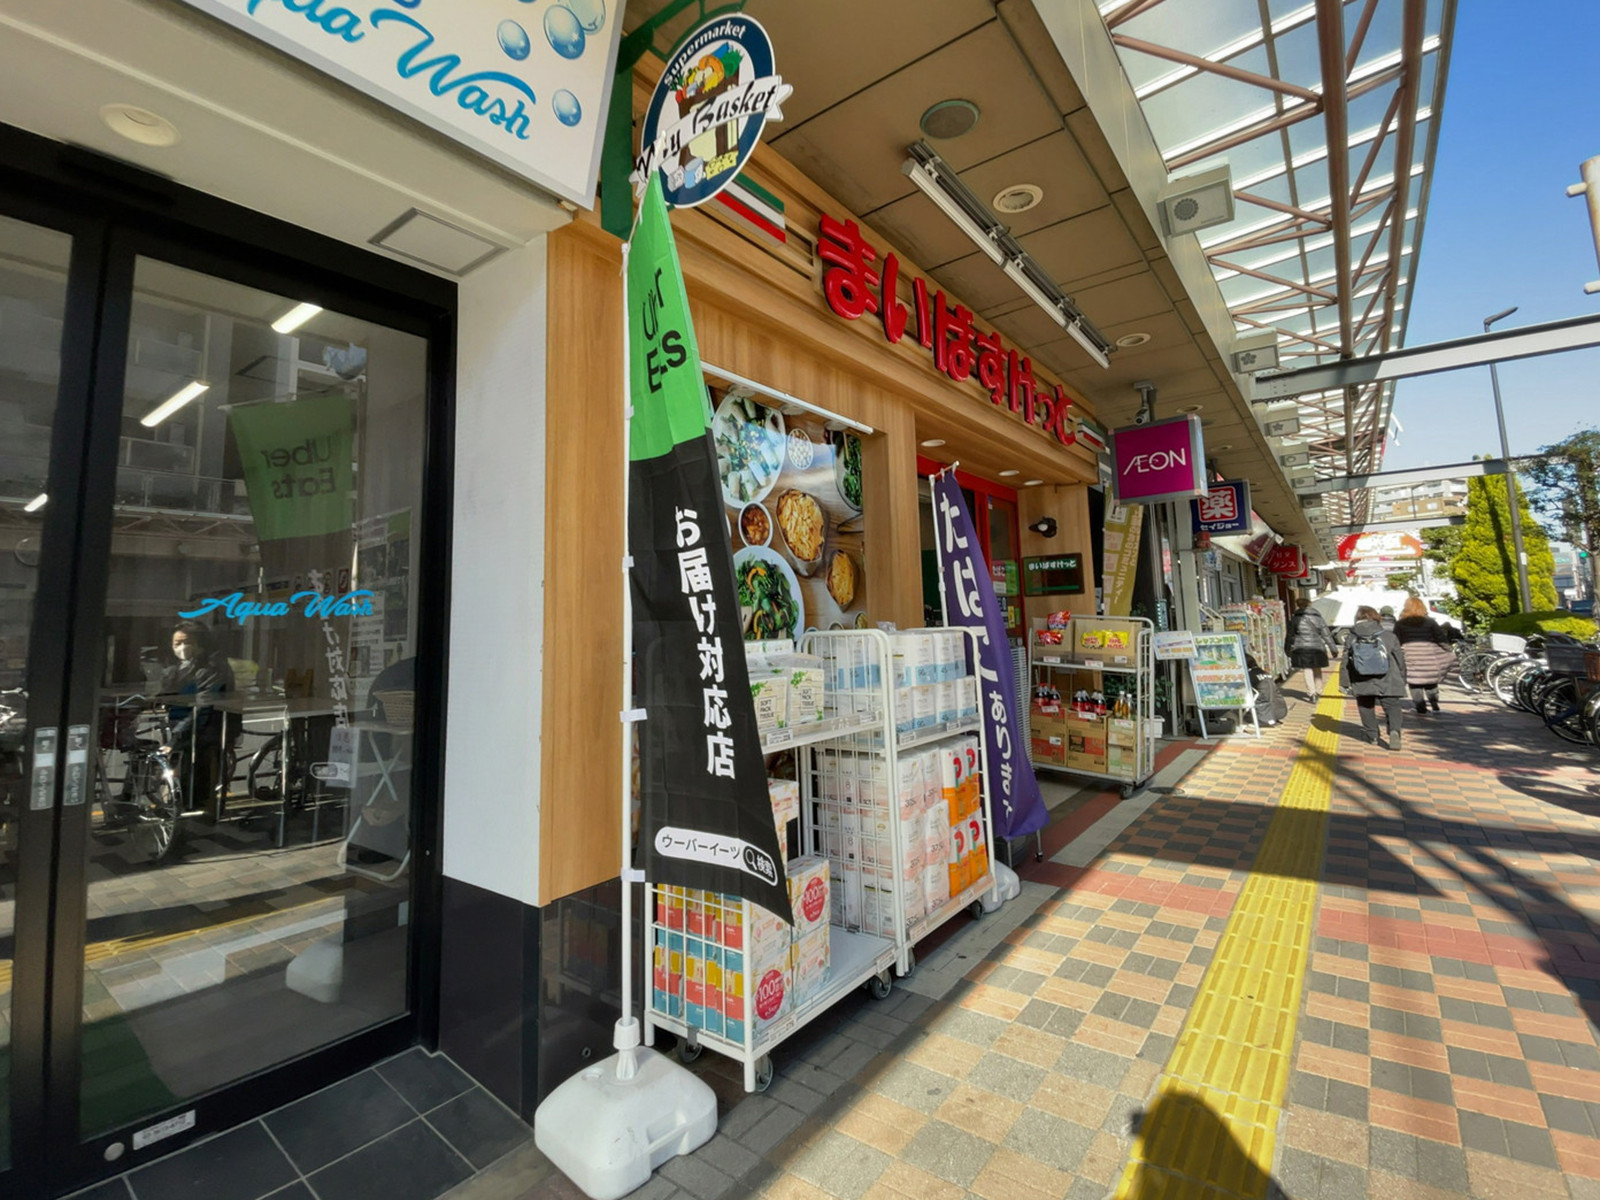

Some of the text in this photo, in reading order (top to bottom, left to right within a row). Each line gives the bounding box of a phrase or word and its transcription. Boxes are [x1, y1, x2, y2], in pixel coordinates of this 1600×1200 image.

[369, 8, 537, 140] Wash
[664, 20, 746, 86] Supermarket
[692, 80, 778, 135] Basket
[817, 213, 1076, 446] まいばすけっと
[1200, 522, 1240, 531] セイジョー
[1202, 490, 1234, 519] 薬
[178, 589, 375, 626] Aqua Wash
[675, 506, 736, 780] お届け対応店
[662, 834, 741, 860] ウーバーイーツ
